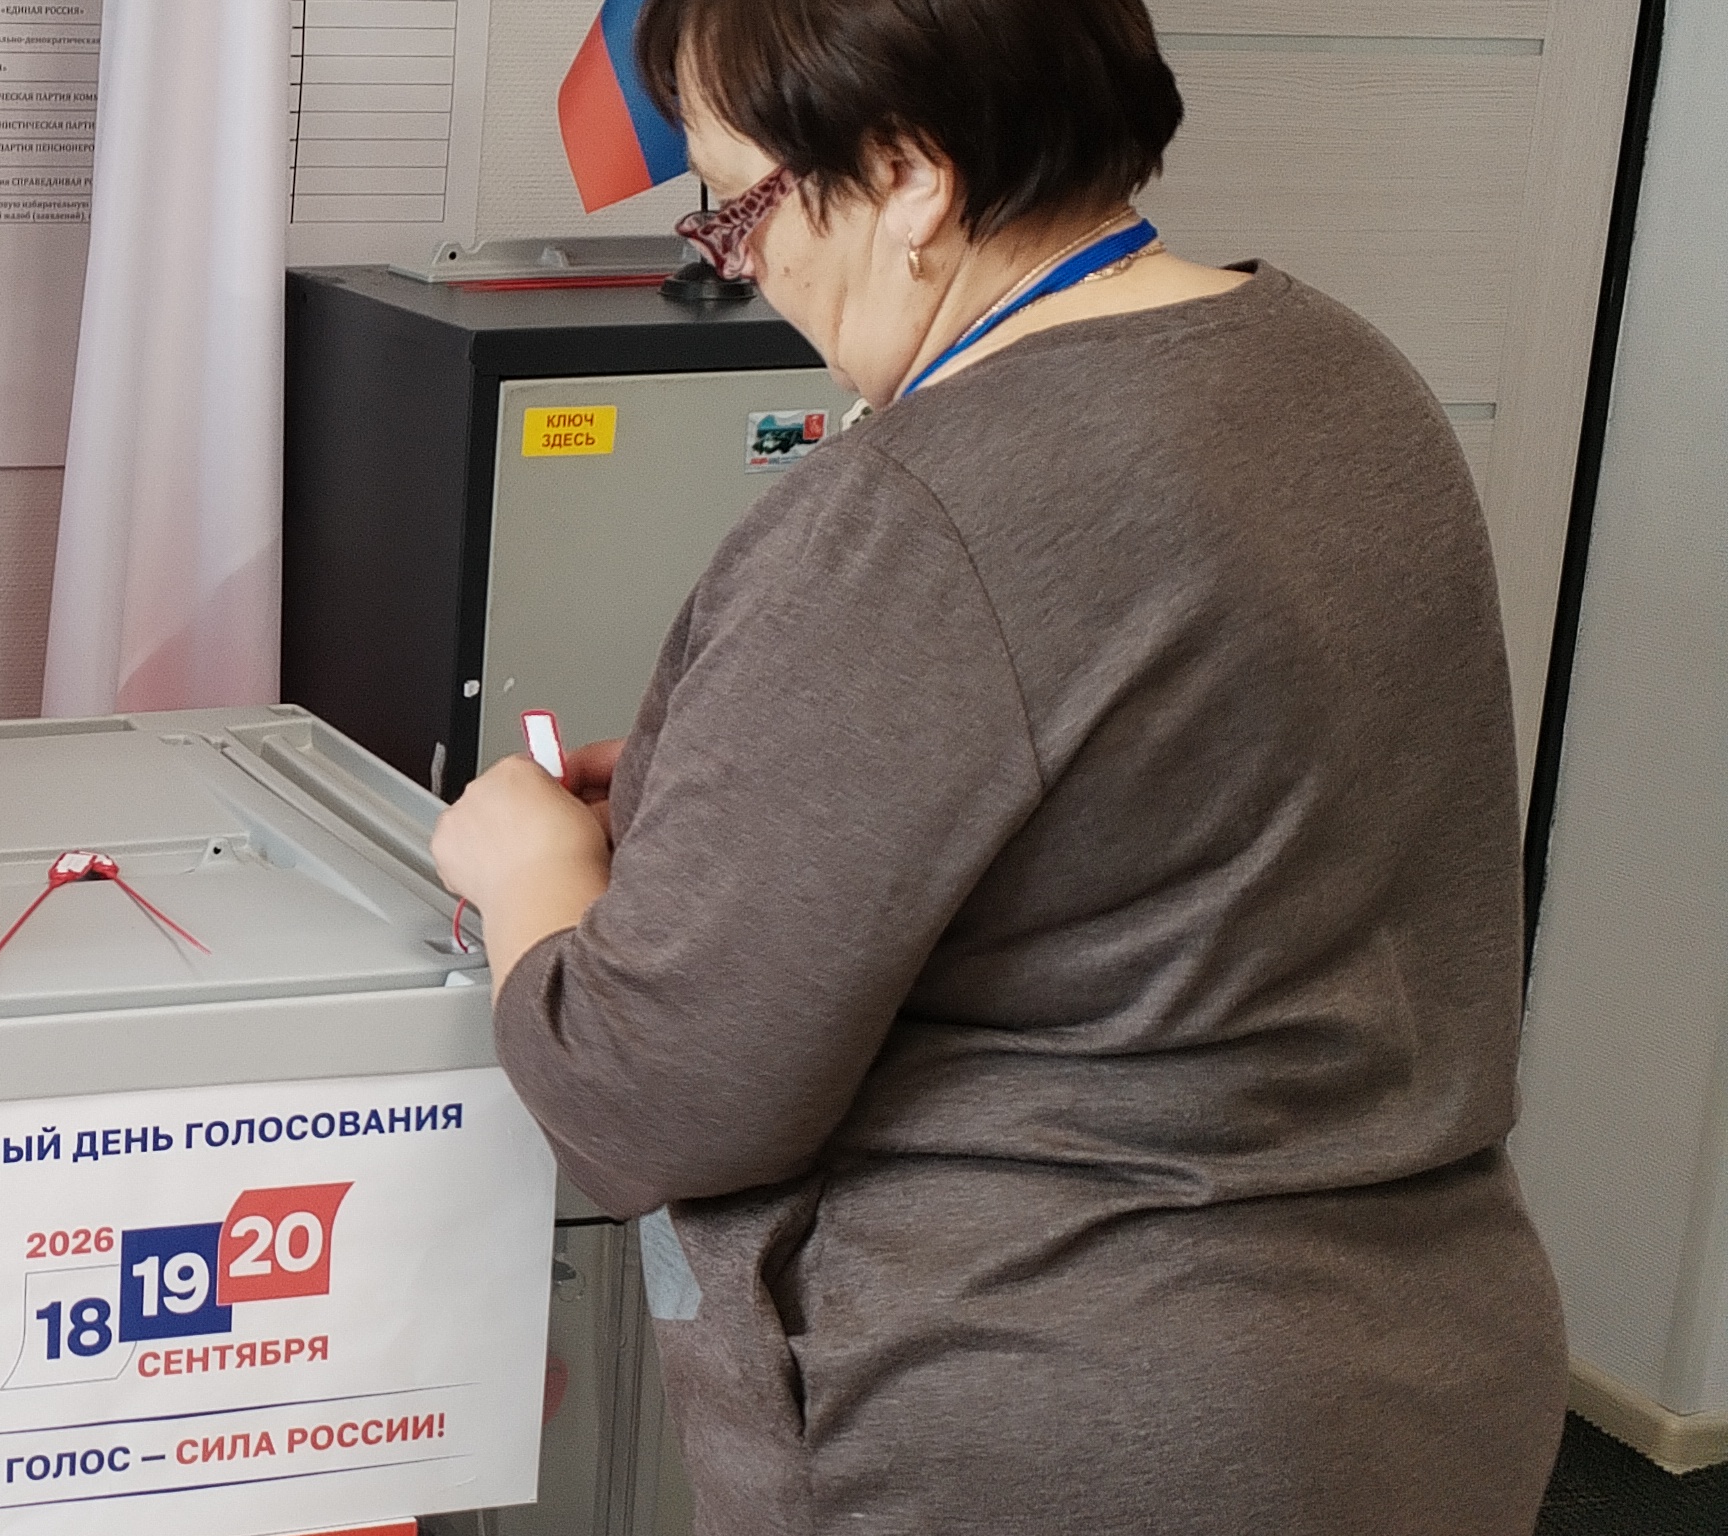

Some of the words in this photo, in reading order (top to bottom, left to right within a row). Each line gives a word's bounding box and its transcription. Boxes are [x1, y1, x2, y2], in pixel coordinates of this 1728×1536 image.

[542, 432, 595, 449] ЗДЕСЬ
[546, 414, 594, 429] КЛЮЧ
[72, 1116, 173, 1163] ДЕНЬ
[184, 1102, 464, 1151] ГОЛОСОВАНИЯ
[25, 1226, 115, 1260] 2026
[227, 1209, 323, 1278] 20
[131, 1251, 210, 1319] 19
[35, 1295, 113, 1361] 18
[136, 1334, 330, 1380] СЕНТЯБРЯ
[5, 1445, 131, 1486] ГОЛОС
[175, 1433, 277, 1467] СИЛА
[286, 1411, 446, 1456] РОССИИ!
